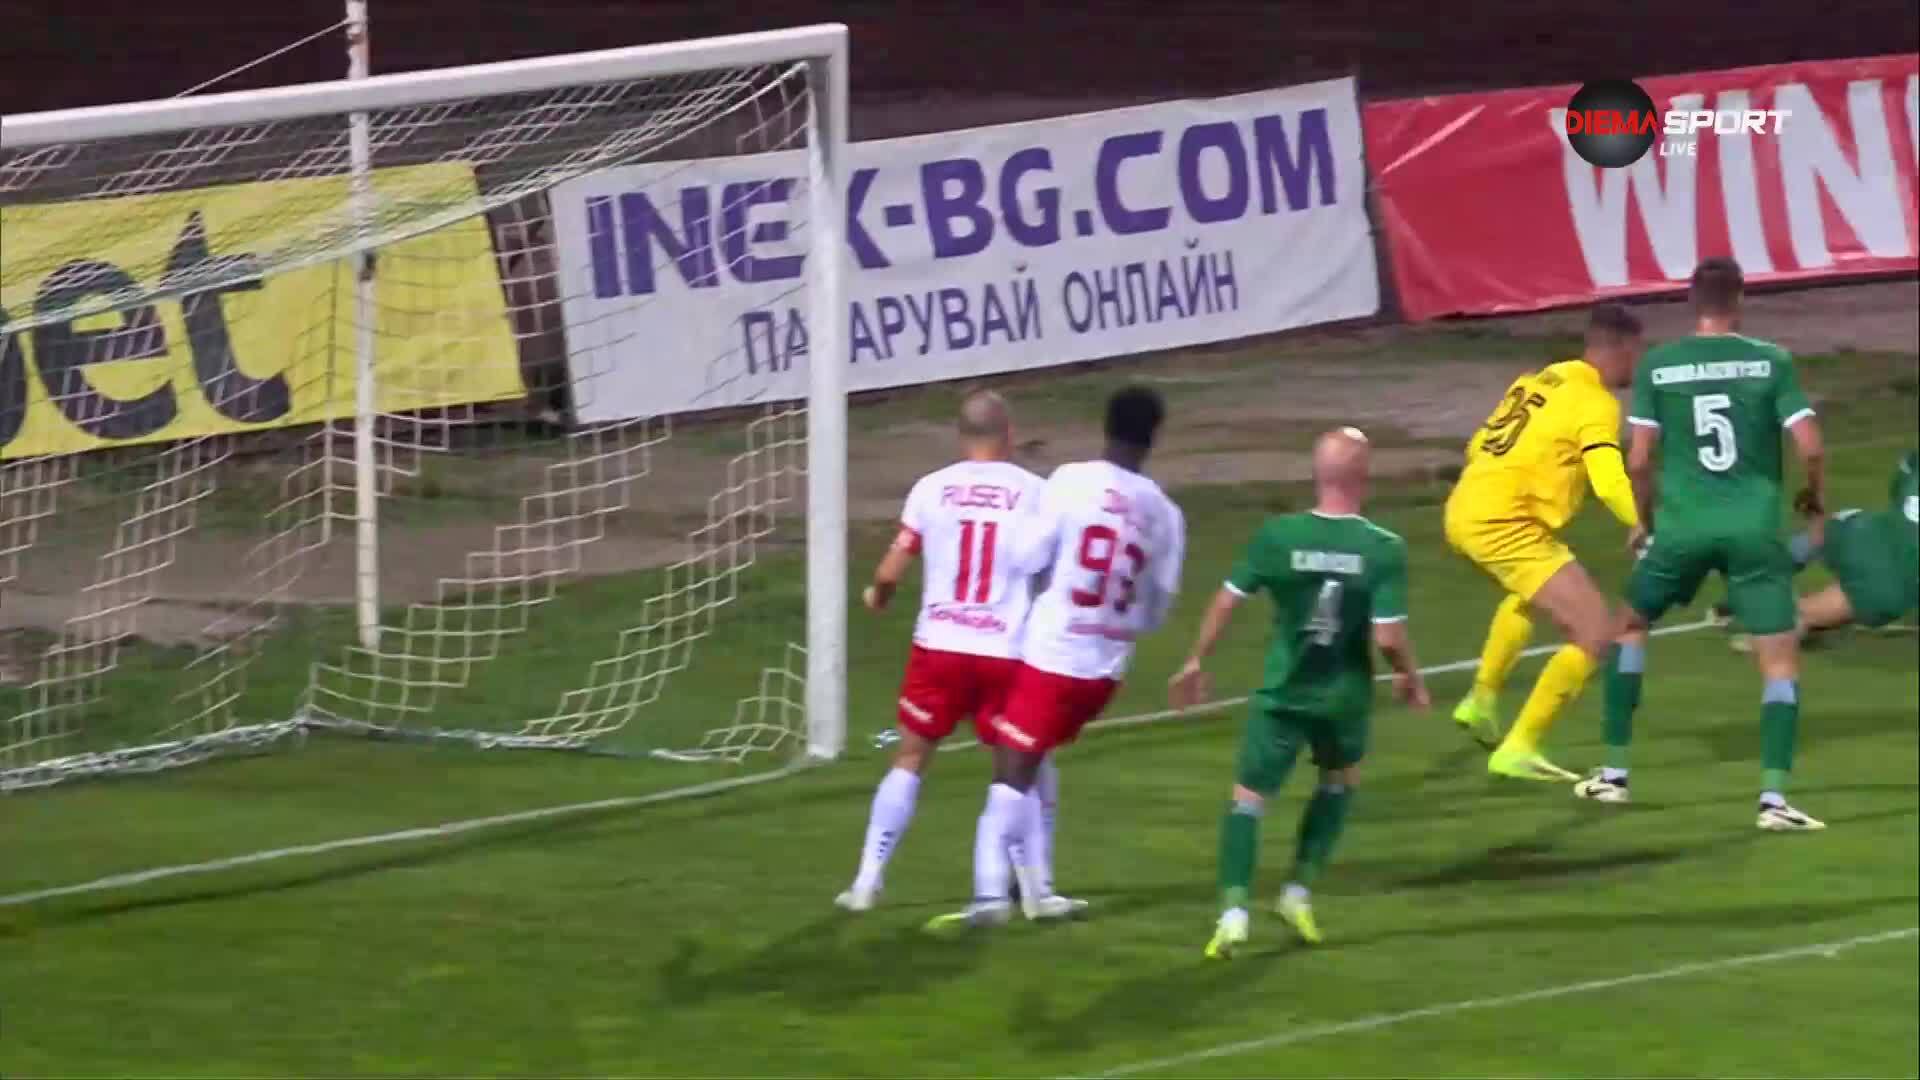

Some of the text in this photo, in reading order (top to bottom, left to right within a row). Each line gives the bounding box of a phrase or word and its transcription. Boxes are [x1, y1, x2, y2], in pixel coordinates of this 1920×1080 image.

[1547, 72, 1919, 288] WIN
[741, 236, 1240, 376] ПААРУВАЙ ОНЛАЙН
[1692, 393, 1739, 473] 5
[940, 484, 1022, 512] RUSEV
[954, 519, 999, 604] 11
